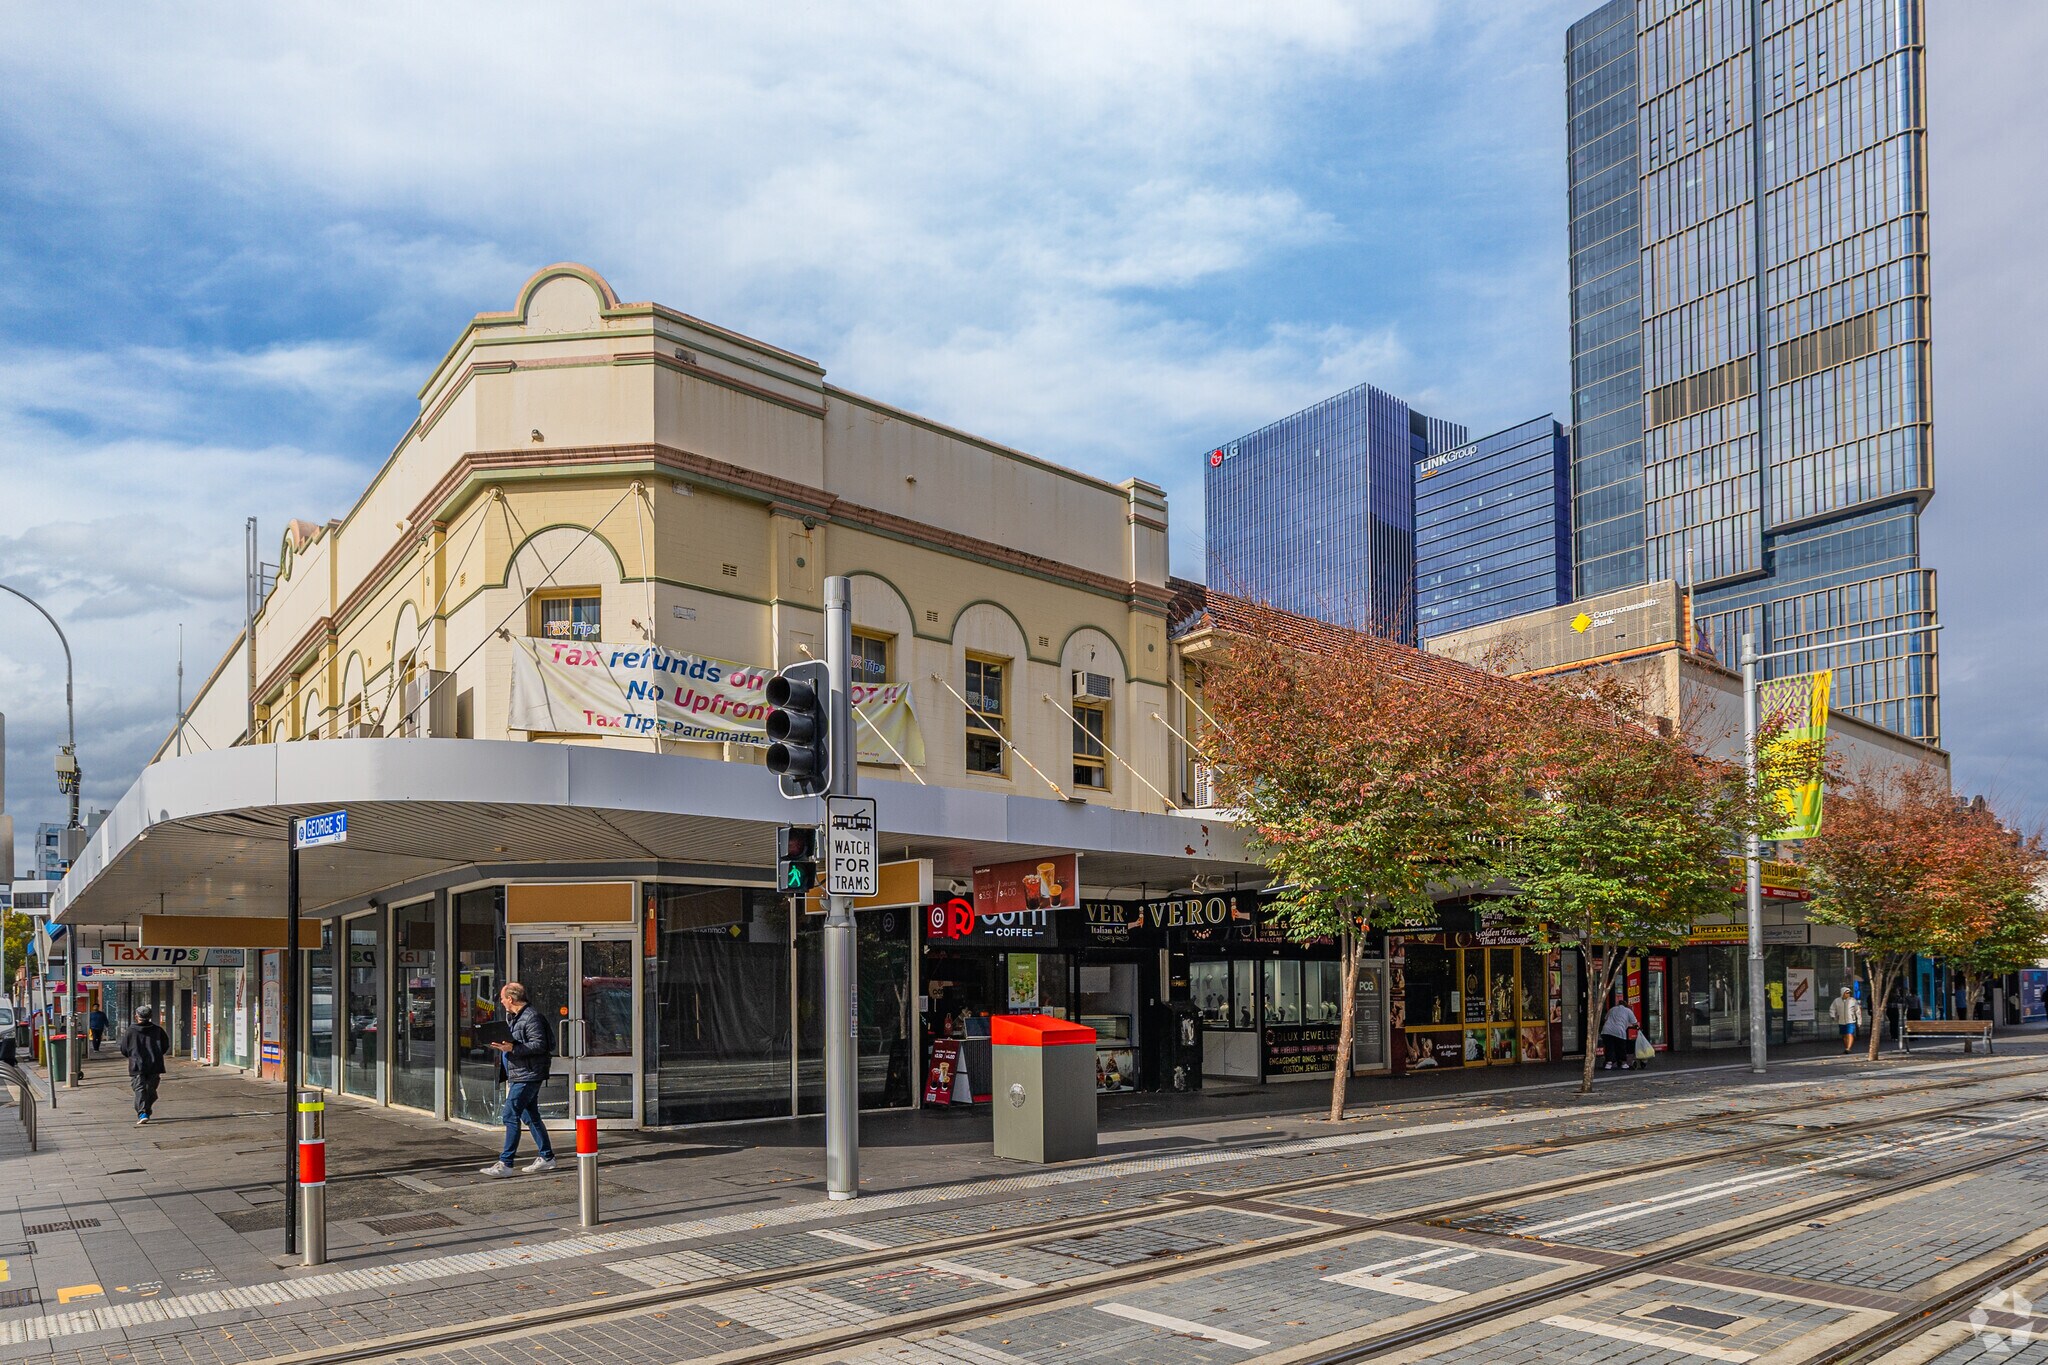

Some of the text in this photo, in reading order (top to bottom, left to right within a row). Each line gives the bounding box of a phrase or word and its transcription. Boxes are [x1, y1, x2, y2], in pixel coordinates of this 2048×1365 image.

[1223, 445, 1240, 460] LG
[1594, 599, 1660, 618] Commonwealth
[545, 624, 570, 636] Tax
[572, 621, 600, 637] Tips
[1593, 617, 1615, 628] Bank
[551, 643, 763, 690] Tax refunds on
[864, 658, 886, 674] Tips
[626, 680, 775, 721] No Upfront
[307, 814, 345, 837] GEORGE ST
[835, 840, 870, 855] WATCH
[835, 858, 869, 872] FOR
[835, 876, 870, 890] TRAMS
[1086, 904, 1126, 922] VER
[1148, 897, 1227, 928] VERO
[1405, 918, 1422, 927] PCG
[1721, 925, 1748, 933] LOANS
[996, 927, 1033, 937] COFFEE
[1091, 926, 1113, 934] Italian
[1475, 927, 1516, 939] Golden Tree
[1480, 936, 1530, 945] Thai Massage
[1359, 981, 1374, 991] PCG
[1278, 1031, 1298, 1041] DLUX
[1269, 1055, 1300, 1065] ENGAGEMENT
[1302, 1054, 1316, 1063] RINGS
[1283, 1063, 1304, 1073] CUSTOM
